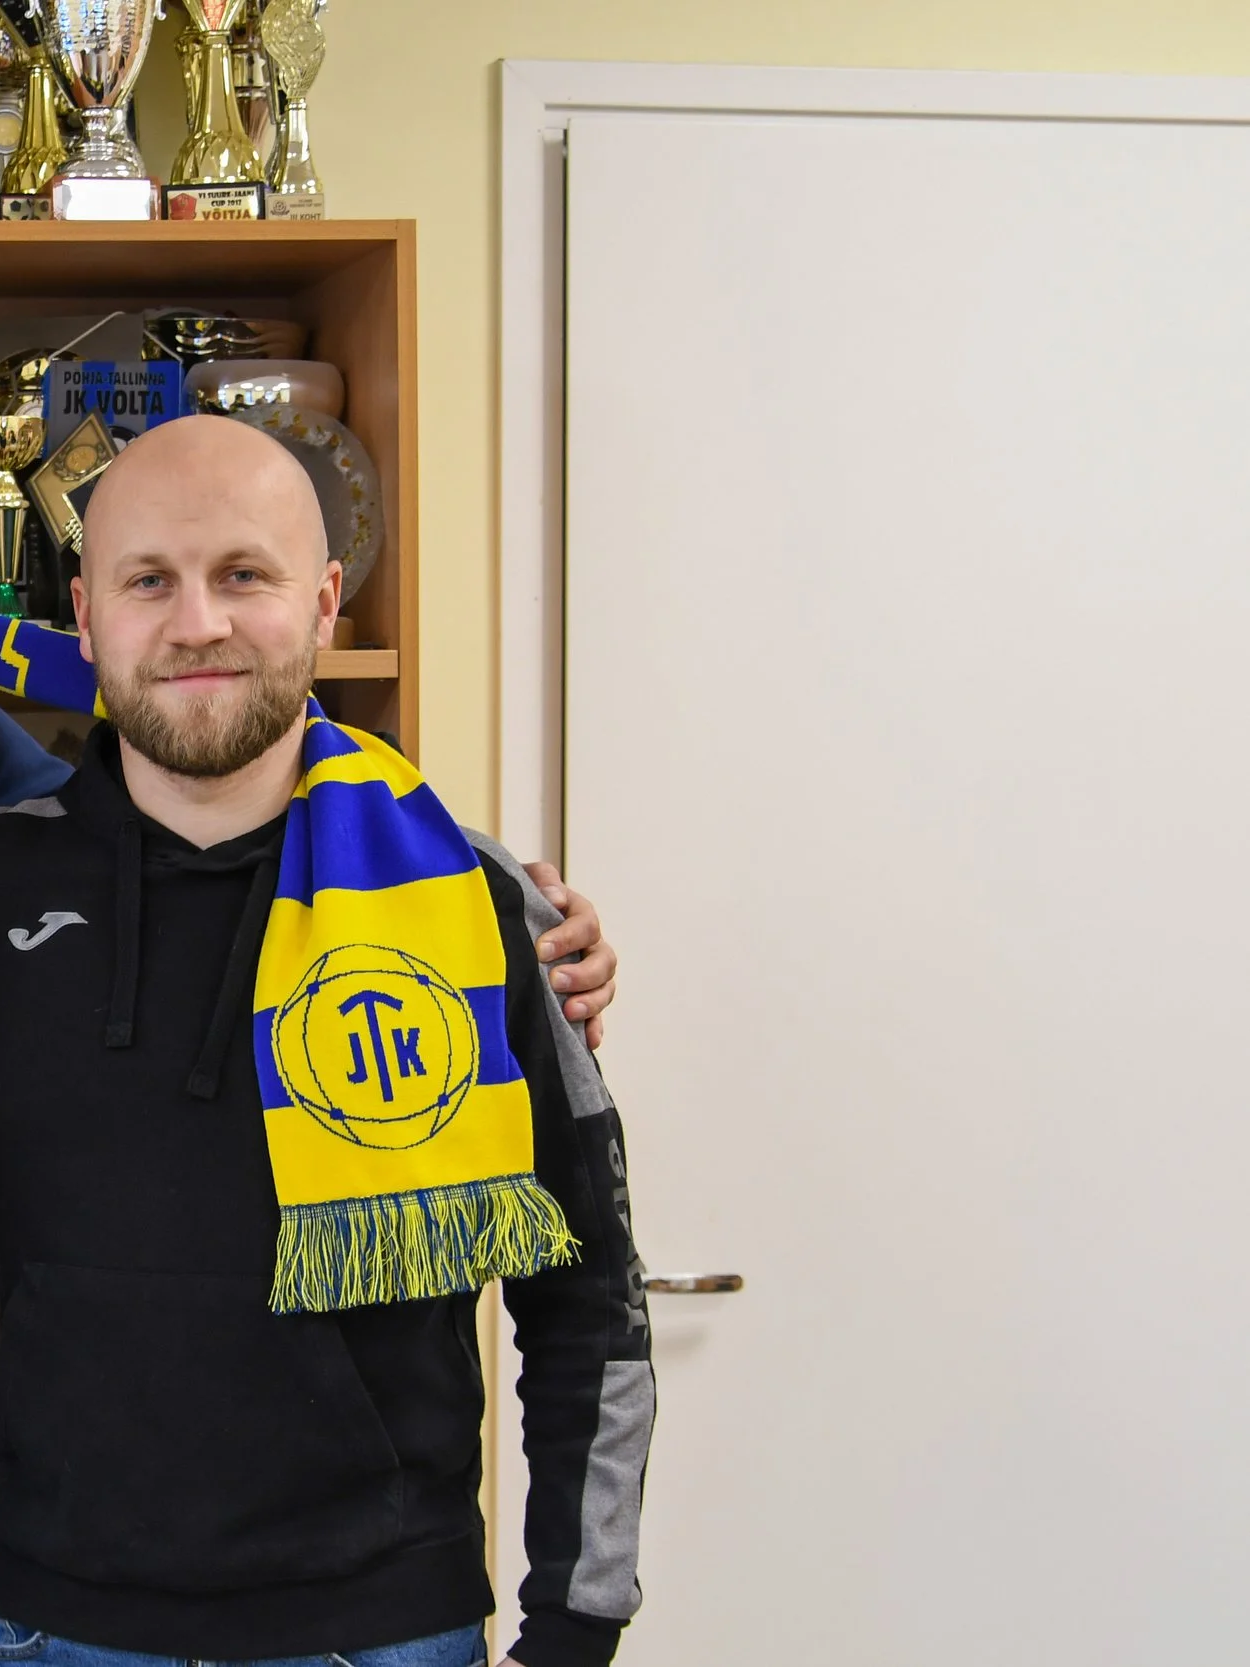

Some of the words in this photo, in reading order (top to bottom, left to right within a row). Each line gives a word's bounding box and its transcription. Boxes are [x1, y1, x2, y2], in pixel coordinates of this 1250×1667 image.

[202, 208, 251, 220] VÕITJA
[63, 390, 87, 415] JK
[96, 390, 165, 415] VOLTA
